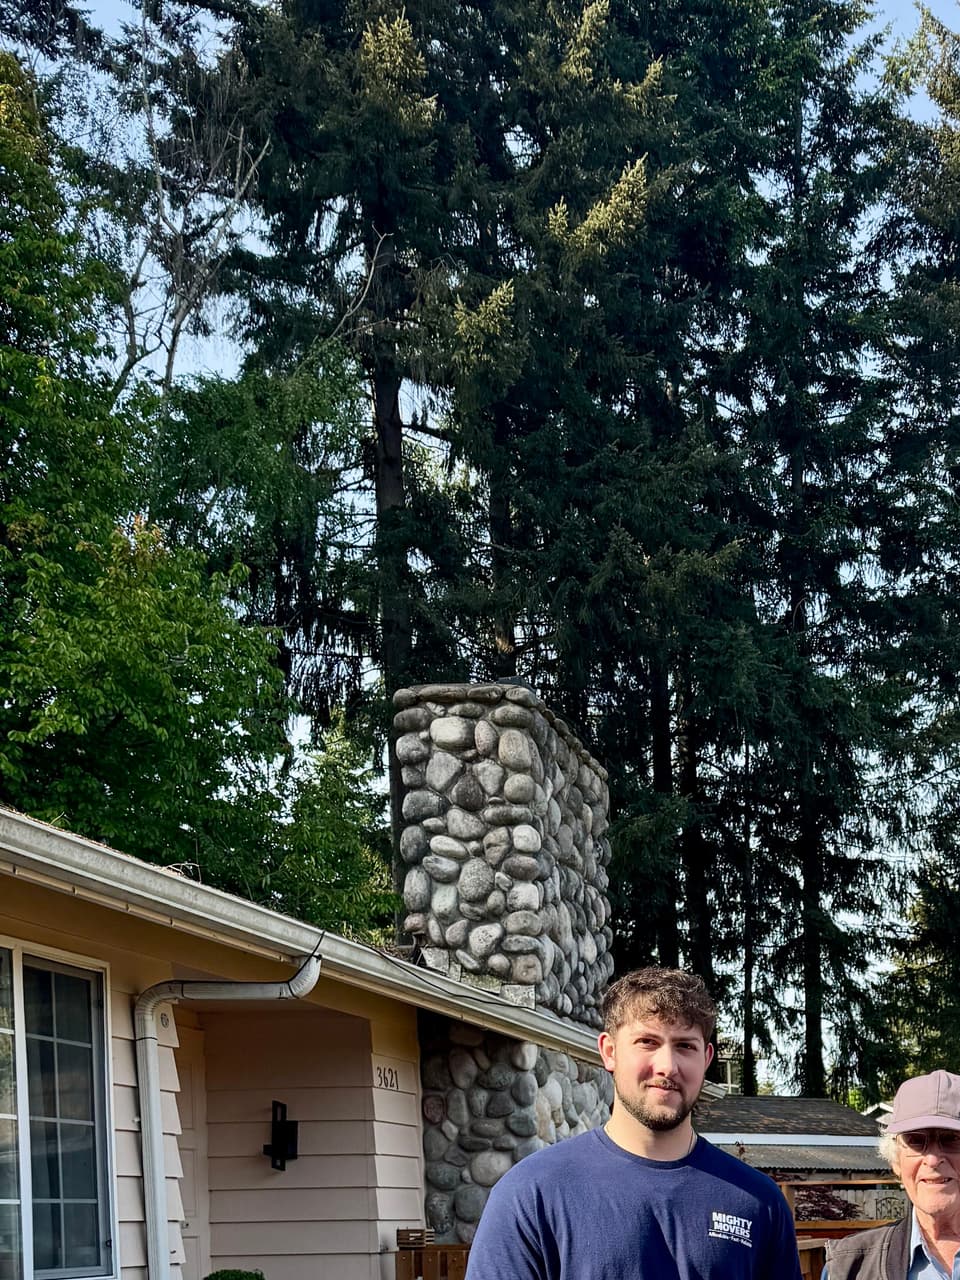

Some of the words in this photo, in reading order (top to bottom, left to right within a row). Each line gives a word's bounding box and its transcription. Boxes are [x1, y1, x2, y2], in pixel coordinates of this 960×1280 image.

[376, 1066, 399, 1090] 3621
[712, 1211, 752, 1230] MIGHTY
[713, 1221, 751, 1239] MOVERS
